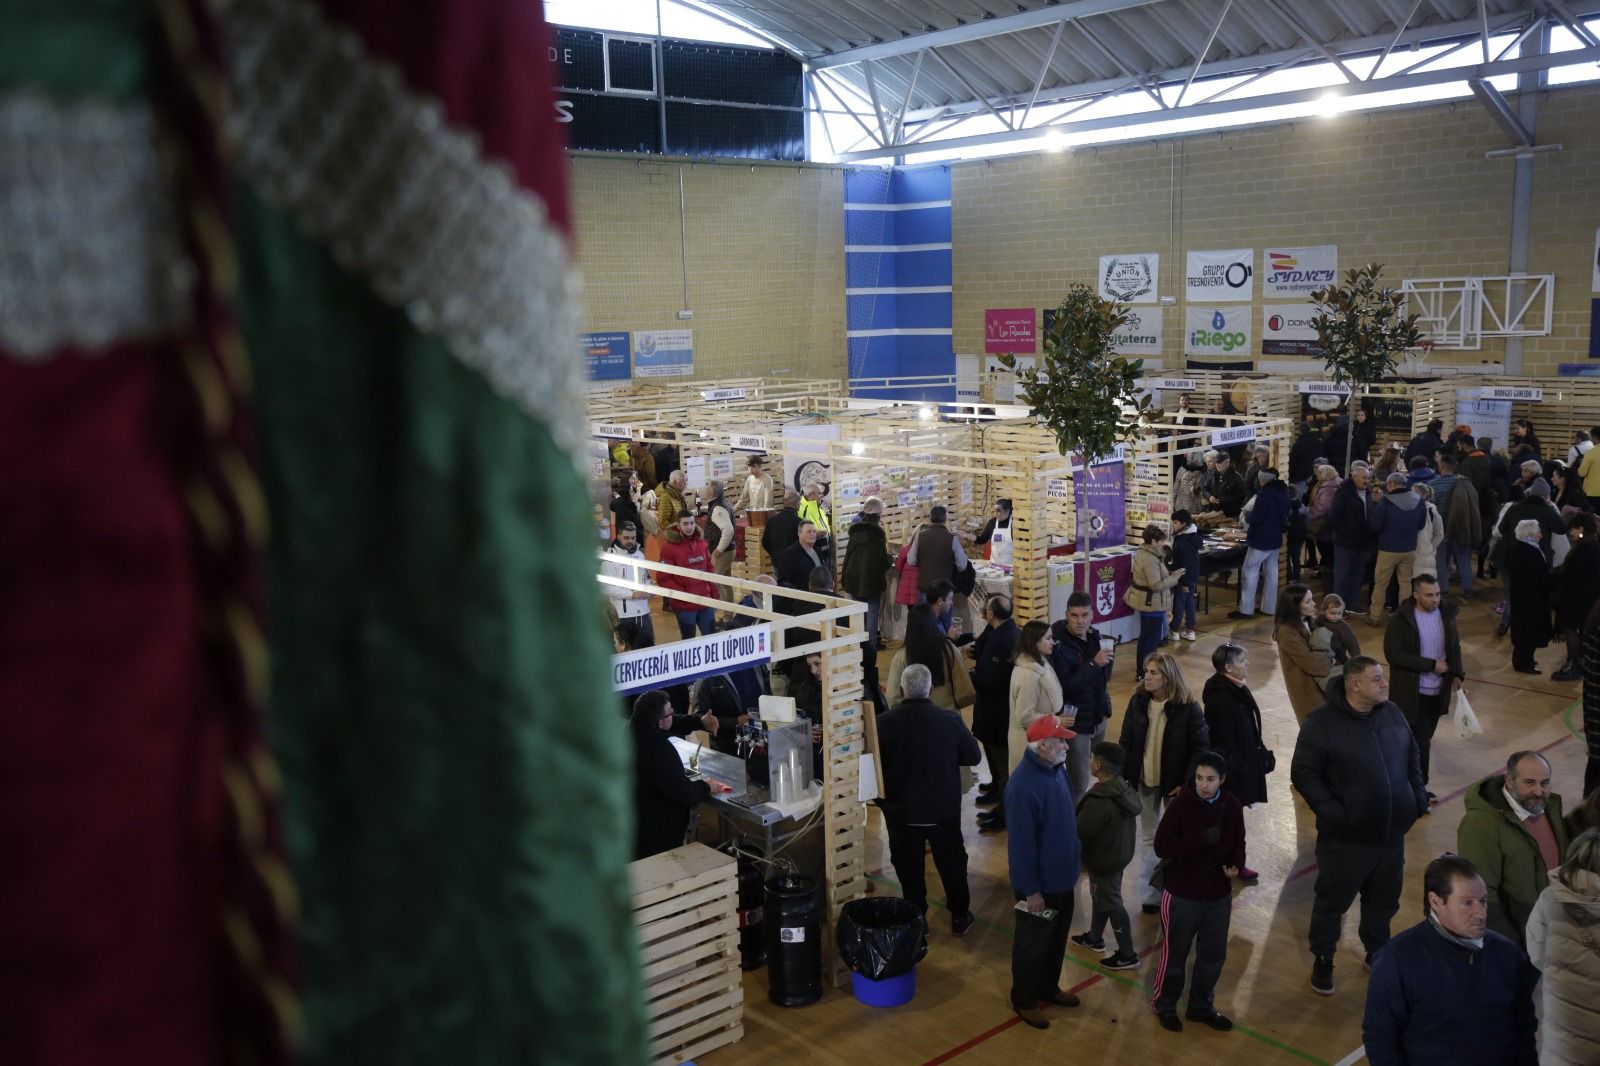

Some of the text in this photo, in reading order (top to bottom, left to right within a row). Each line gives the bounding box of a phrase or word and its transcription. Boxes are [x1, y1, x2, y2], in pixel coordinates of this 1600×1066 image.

[548, 47, 573, 64] DE
[1203, 265, 1224, 277] GRUPO
[1267, 270, 1335, 283] SYDNEY
[1187, 276, 1225, 287] TRESNOVENTA
[1191, 329, 1246, 352] iRiego
[614, 635, 755, 685] CERVECERÍA VALLES DEL LÚPULO
